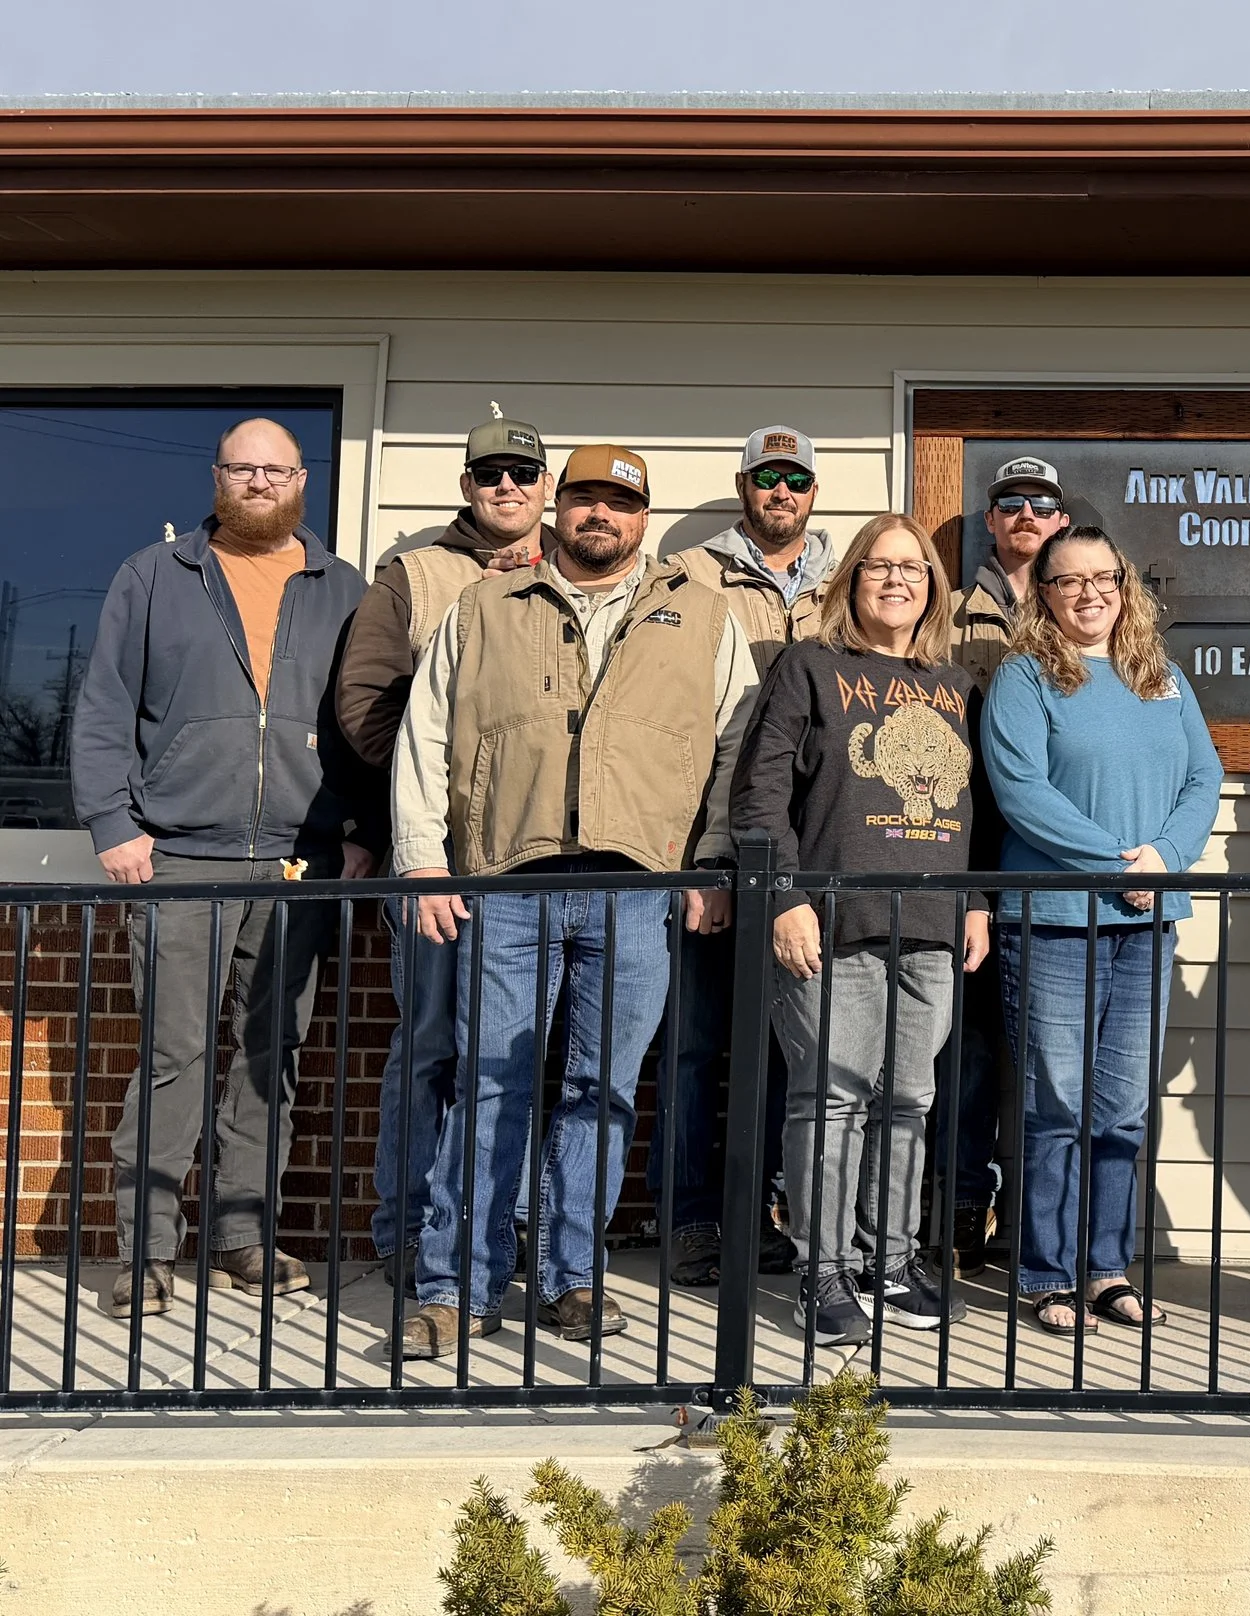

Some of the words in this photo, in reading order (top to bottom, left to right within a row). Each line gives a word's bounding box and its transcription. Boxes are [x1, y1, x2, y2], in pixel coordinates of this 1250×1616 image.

[766, 435, 796, 449] AVEC
[612, 459, 642, 485] AVEC
[1124, 468, 1187, 504] ARK
[1194, 646, 1222, 675] 10
[835, 669, 879, 715] DEF
[884, 677, 966, 725] LEPPARD
[866, 815, 908, 826] ROCK
[912, 817, 932, 827] OF
[933, 820, 962, 832] AGES
[904, 829, 937, 841] 1983
